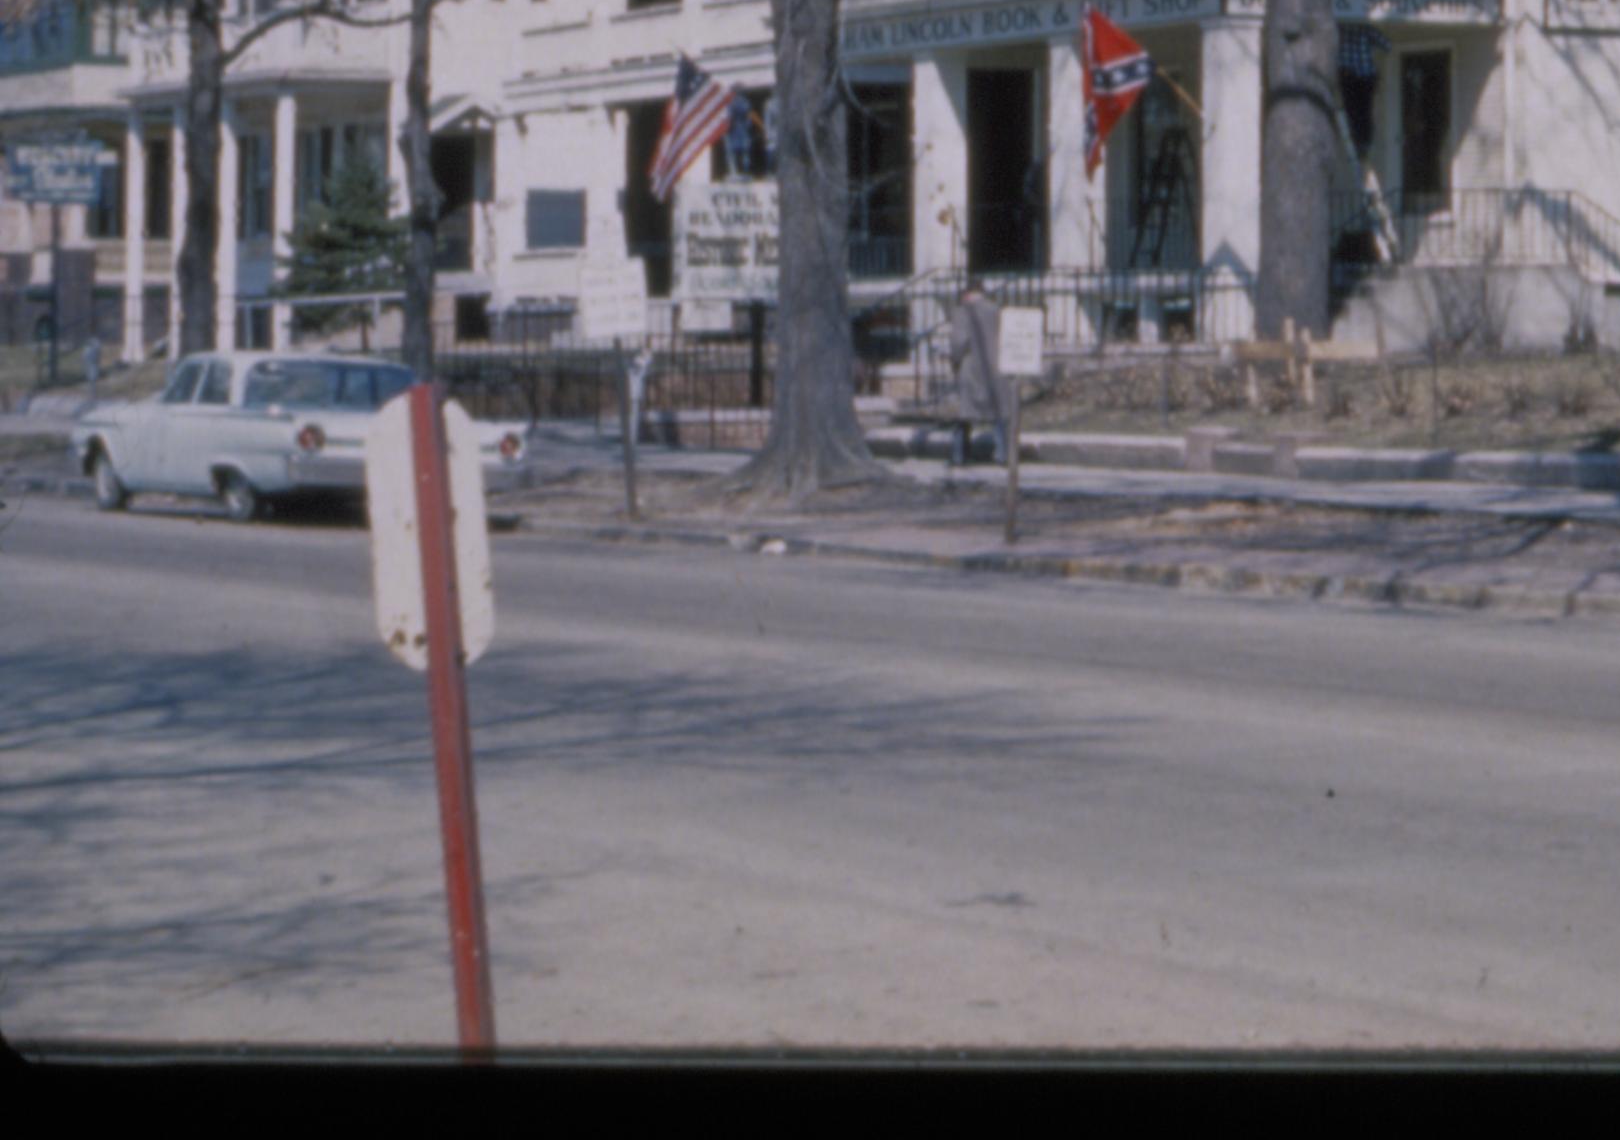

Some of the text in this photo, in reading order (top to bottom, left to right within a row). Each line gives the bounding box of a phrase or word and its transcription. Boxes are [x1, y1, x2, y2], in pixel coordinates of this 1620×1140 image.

[891, 13, 972, 45] LINCOLN
[983, 3, 1041, 33] BOOK
[1052, 4, 1069, 25] &
